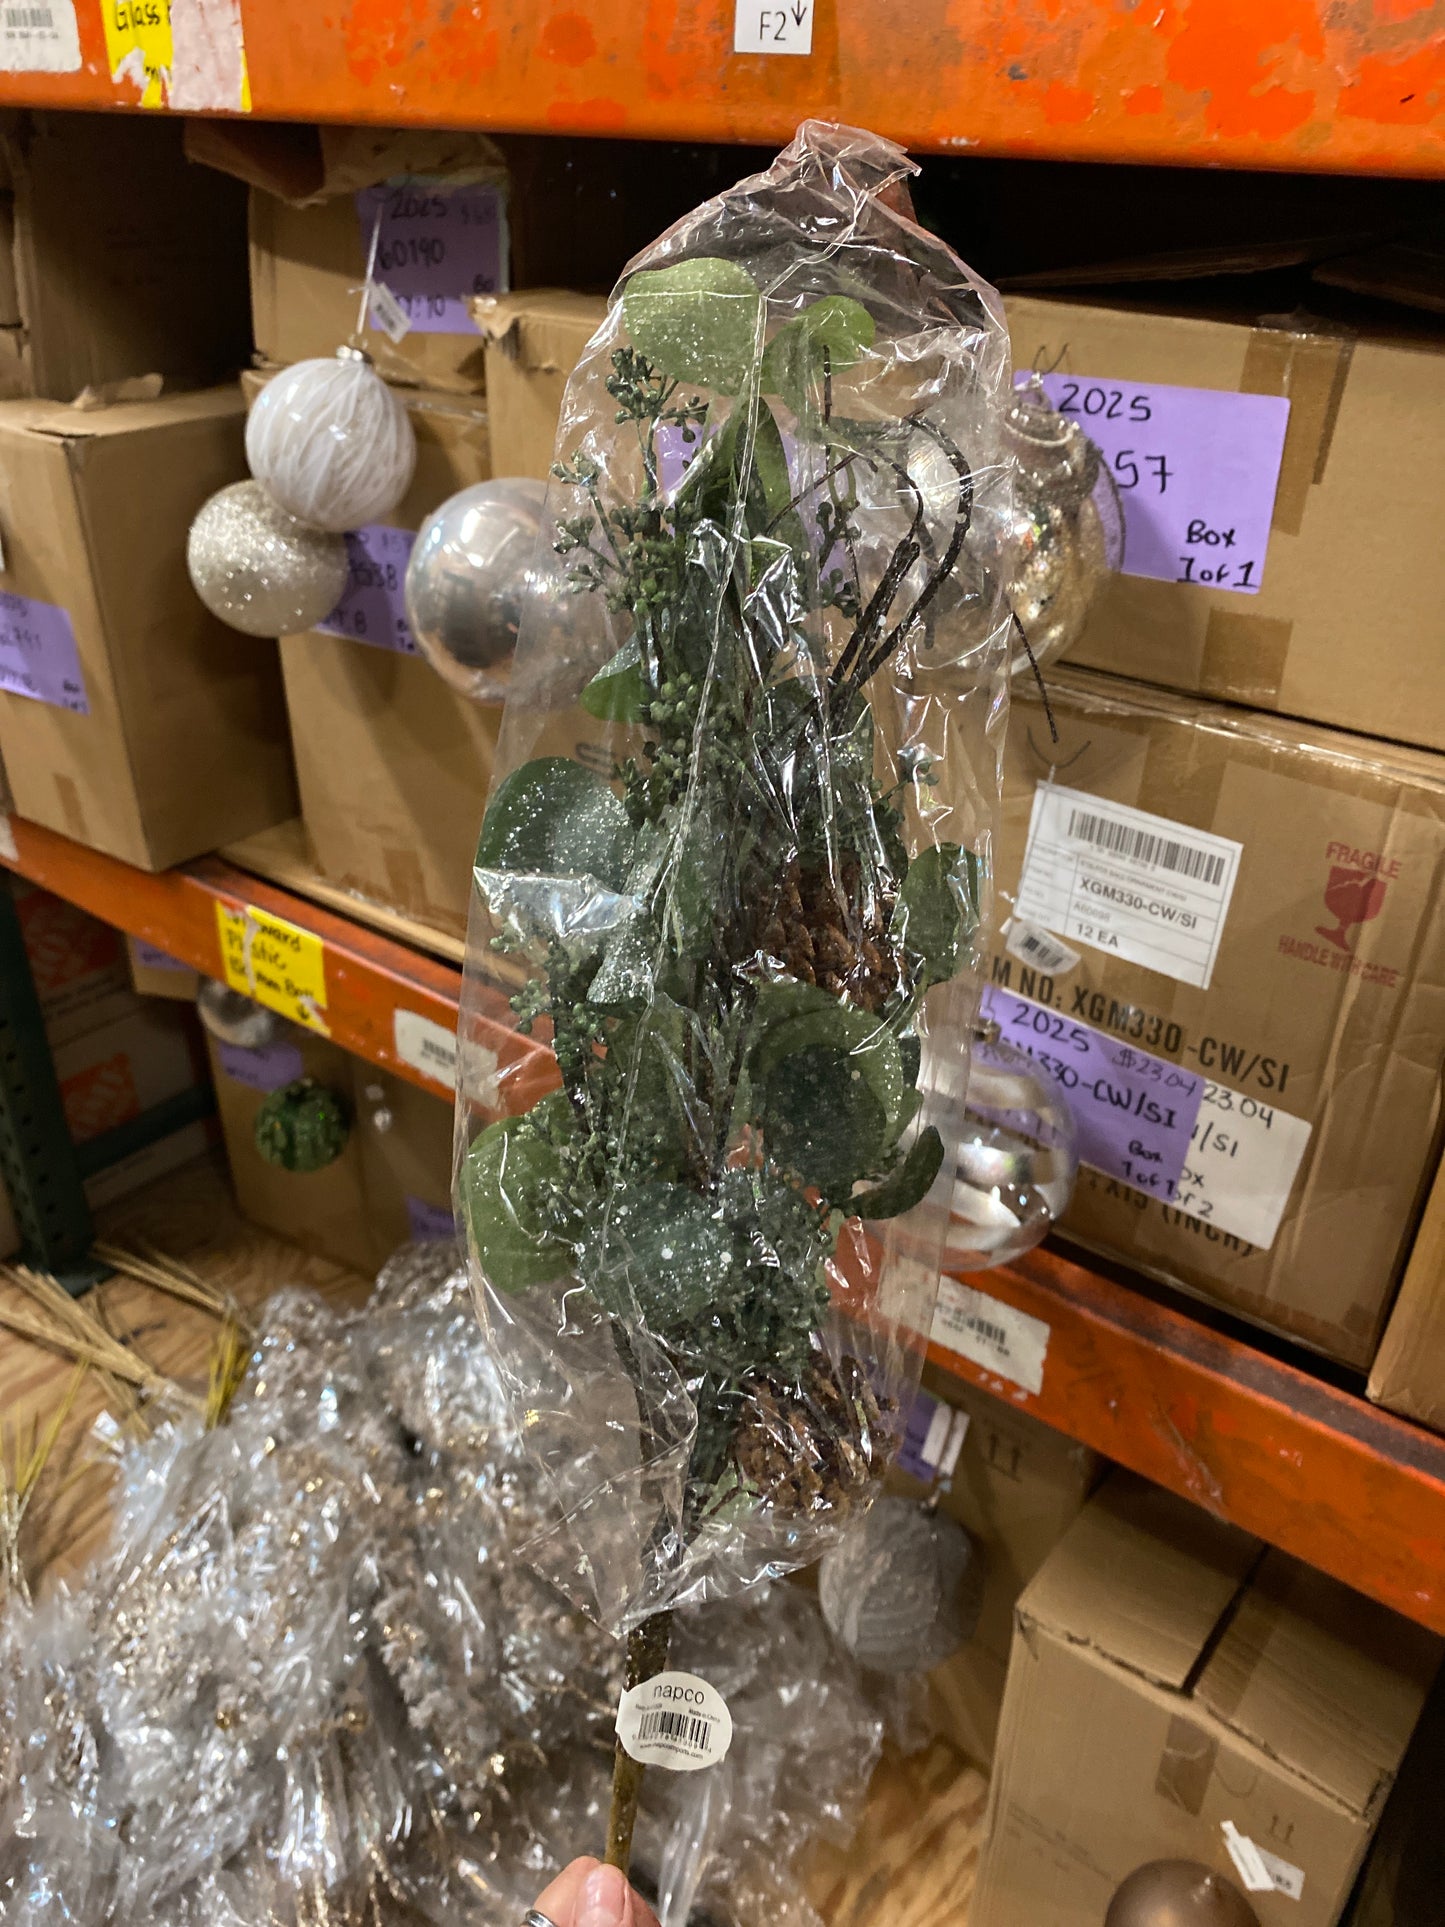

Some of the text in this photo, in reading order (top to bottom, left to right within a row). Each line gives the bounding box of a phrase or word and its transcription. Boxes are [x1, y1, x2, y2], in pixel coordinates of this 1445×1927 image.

[759, 11, 787, 41] F2
[1058, 383, 1152, 422] 2025
[1186, 519, 1236, 548] Box
[1326, 841, 1402, 880] FRAGILE
[1080, 877, 1198, 930] XGM330-CW/SI
[1077, 922, 1119, 949] 12 EA
[1011, 1002, 1090, 1053] 2025
[1071, 985, 1290, 1093] XGM330-CW/SI
[653, 1684, 705, 1706] napco
